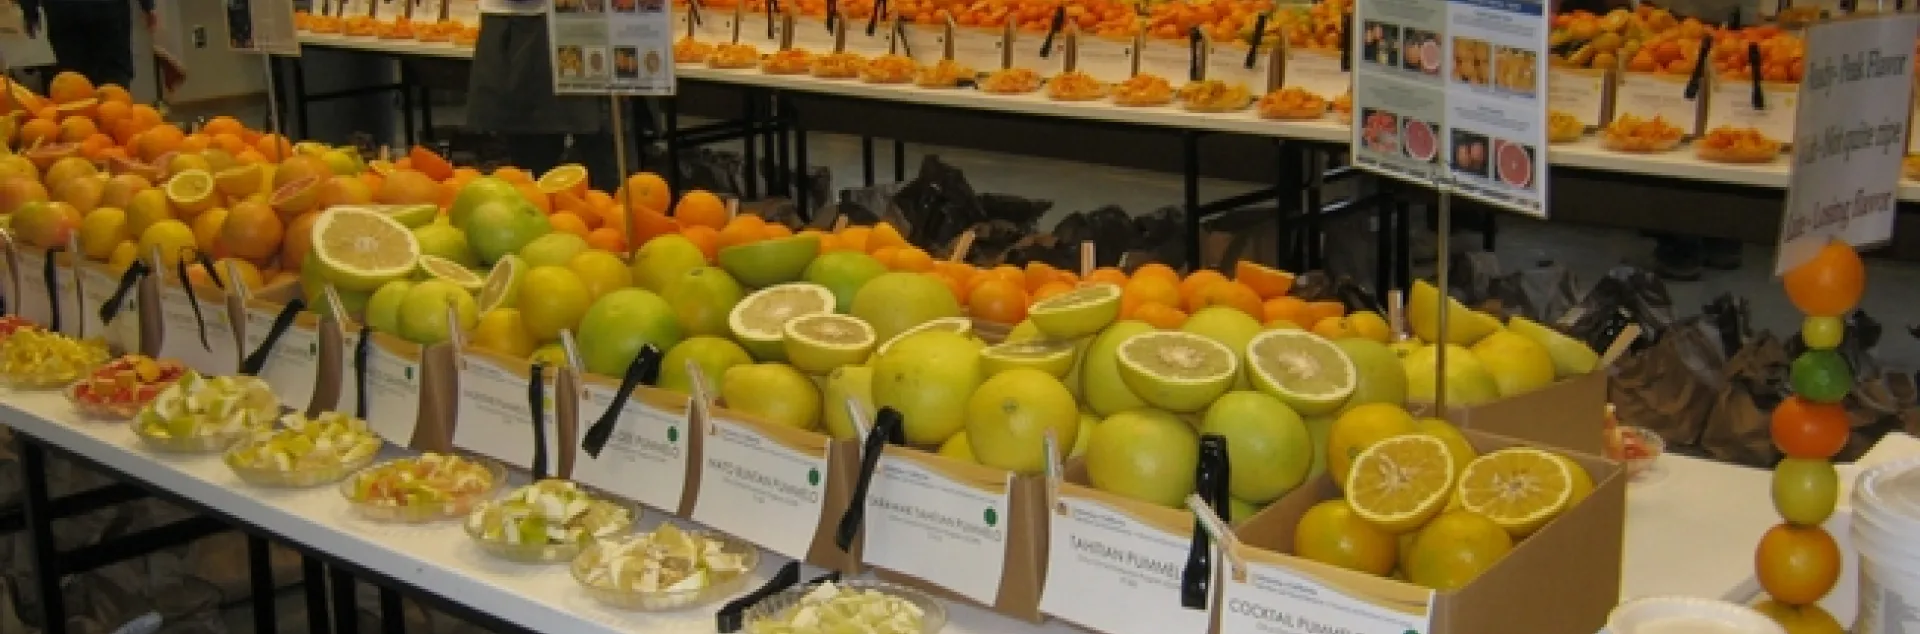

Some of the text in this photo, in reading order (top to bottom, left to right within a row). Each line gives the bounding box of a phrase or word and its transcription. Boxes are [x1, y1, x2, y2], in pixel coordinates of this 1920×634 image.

[1867, 48, 1909, 77] Flavor
[1844, 120, 1874, 161] quite
[1875, 116, 1903, 155] ripe
[1070, 532, 1123, 562] TAHITIAN
[1125, 550, 1181, 580] PUMMEL
[1228, 597, 1294, 628] COCKTAIL
[1297, 615, 1366, 634] PUMM
